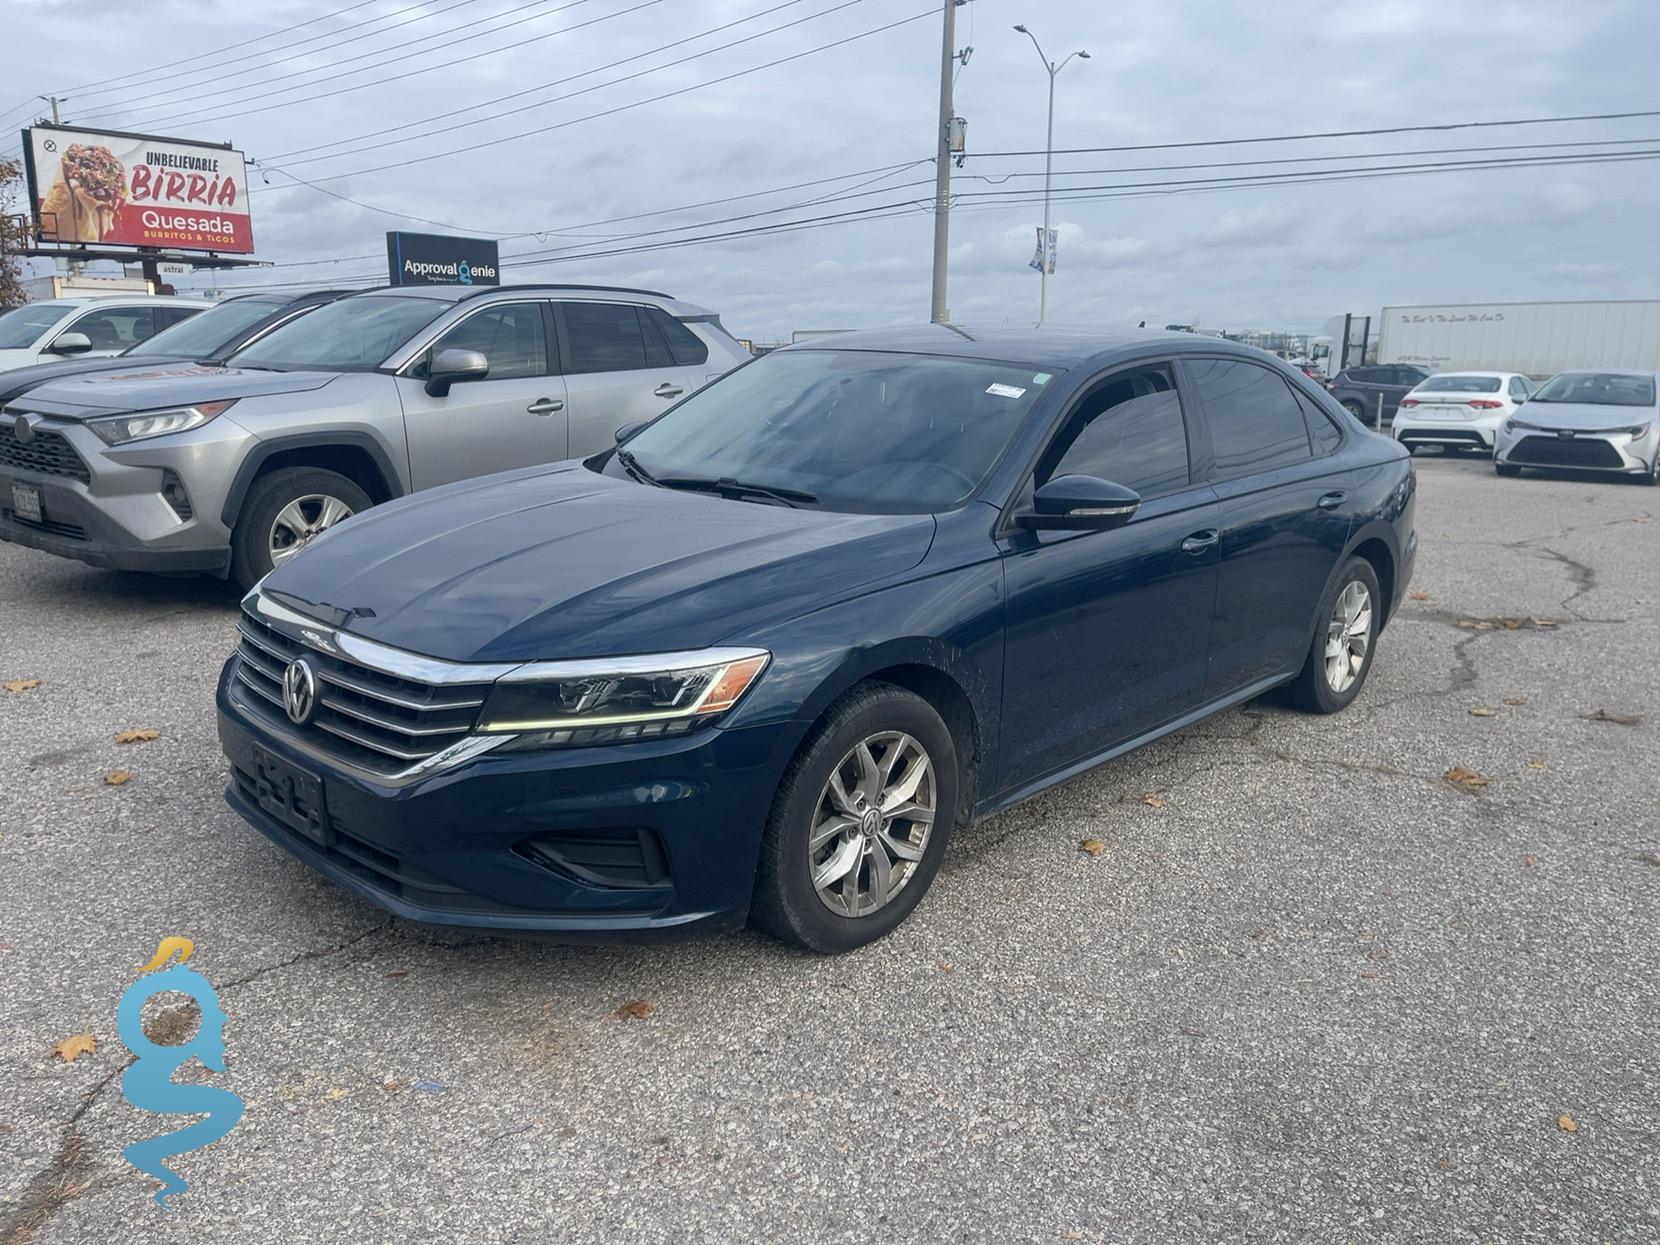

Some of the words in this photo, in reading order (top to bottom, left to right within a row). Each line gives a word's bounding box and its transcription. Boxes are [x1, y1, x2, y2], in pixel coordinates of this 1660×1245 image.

[146, 151, 219, 173] UNBELIEVABLE
[142, 210, 234, 234] Quesada
[143, 230, 193, 240] BURRITOS
[163, 266, 184, 274] astral
